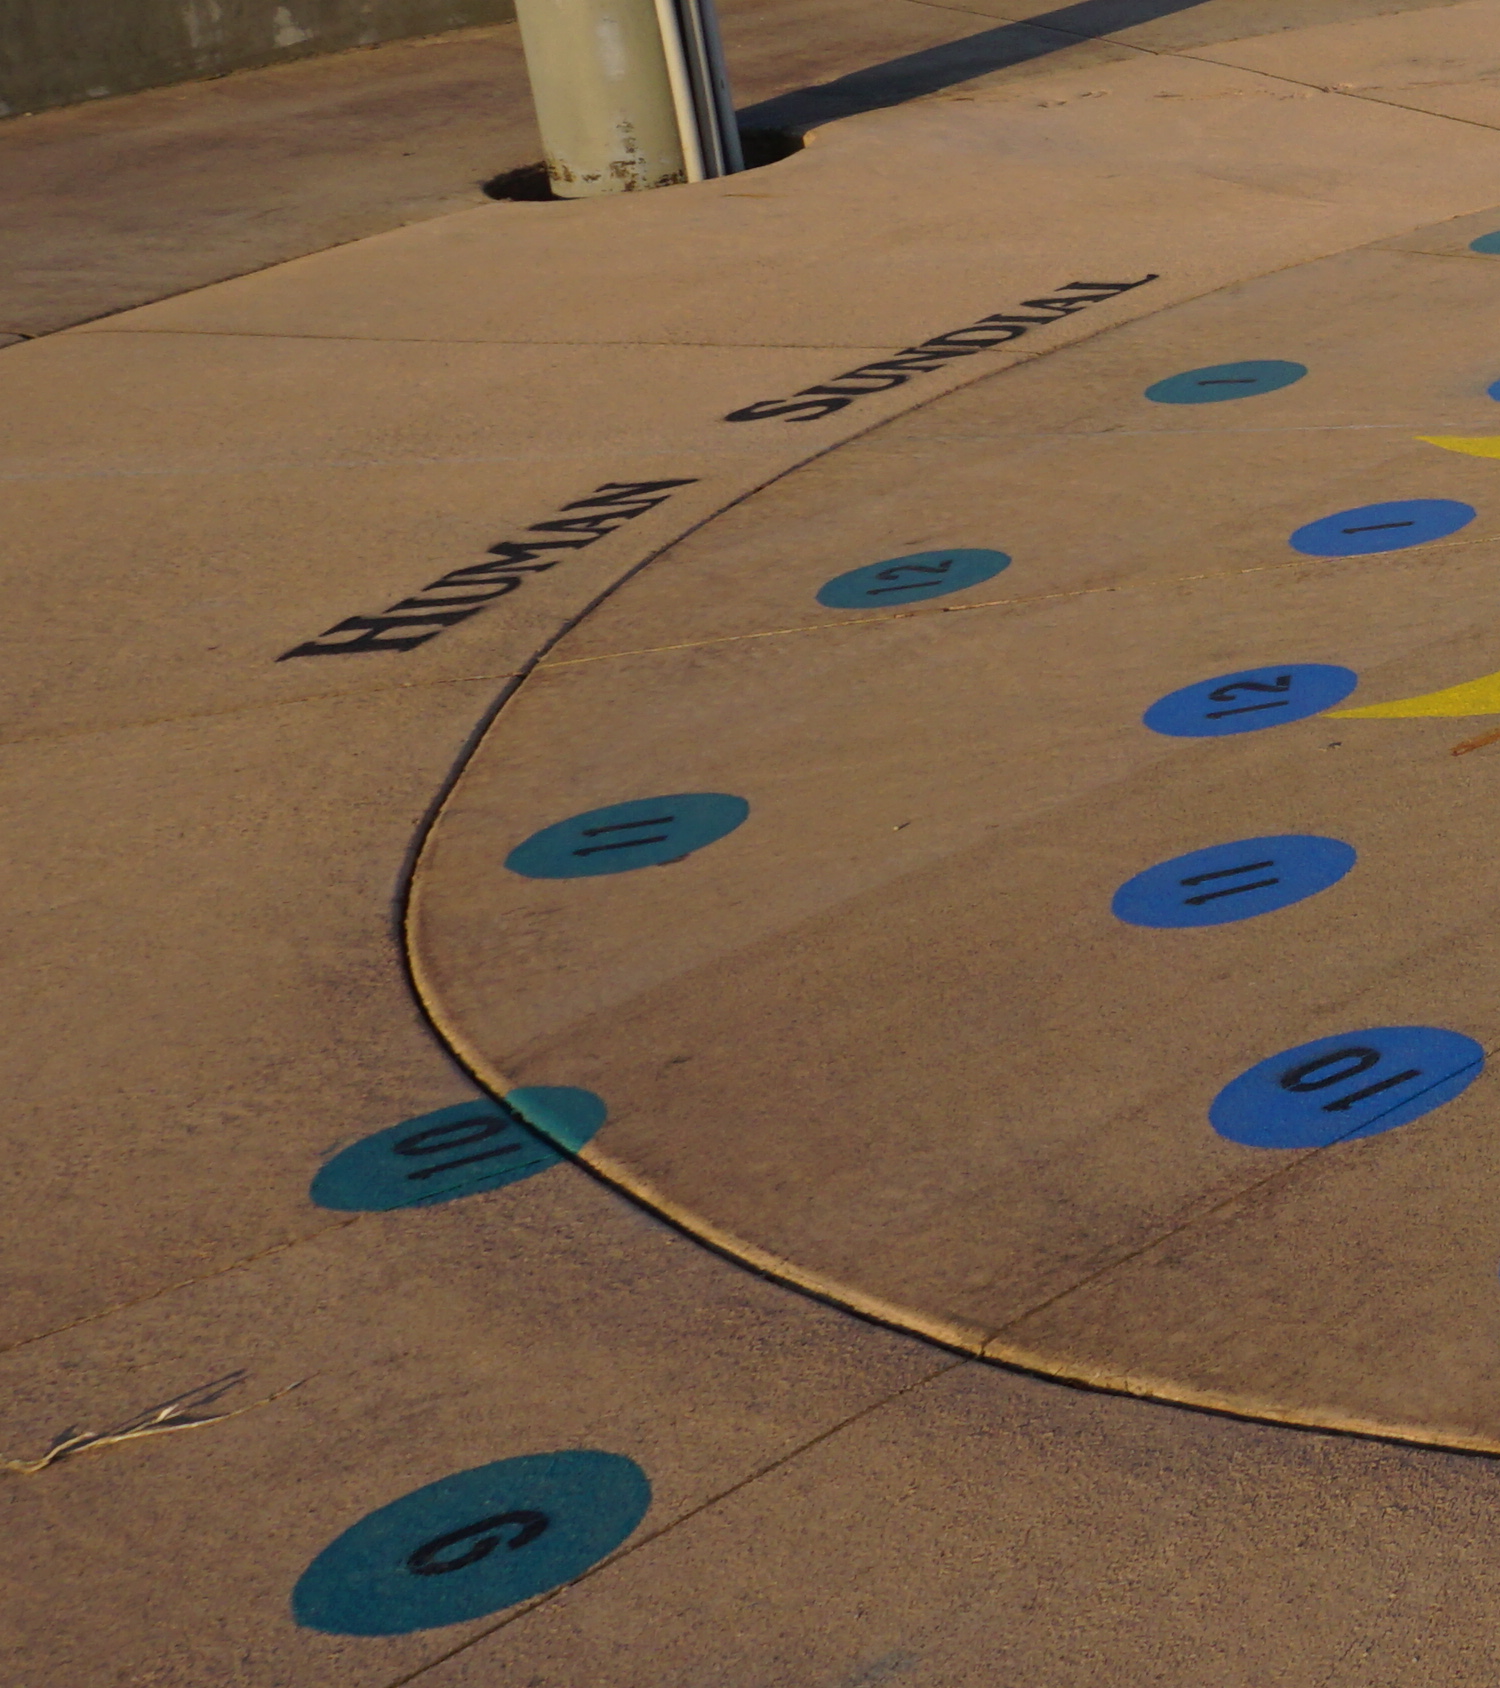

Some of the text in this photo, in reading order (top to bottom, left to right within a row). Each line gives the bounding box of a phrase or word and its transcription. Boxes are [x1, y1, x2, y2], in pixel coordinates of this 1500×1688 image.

[1199, 378, 1258, 386] 1
[276, 272, 1160, 663] HUMAN SUNDIAL
[1342, 520, 1414, 534] 1
[867, 559, 953, 595] 12
[1206, 674, 1292, 720] 12
[572, 815, 675, 856] 11
[1180, 860, 1279, 905] 11
[1281, 1046, 1422, 1112] 10
[394, 1116, 522, 1179] 10
[406, 1510, 550, 1575] 9
